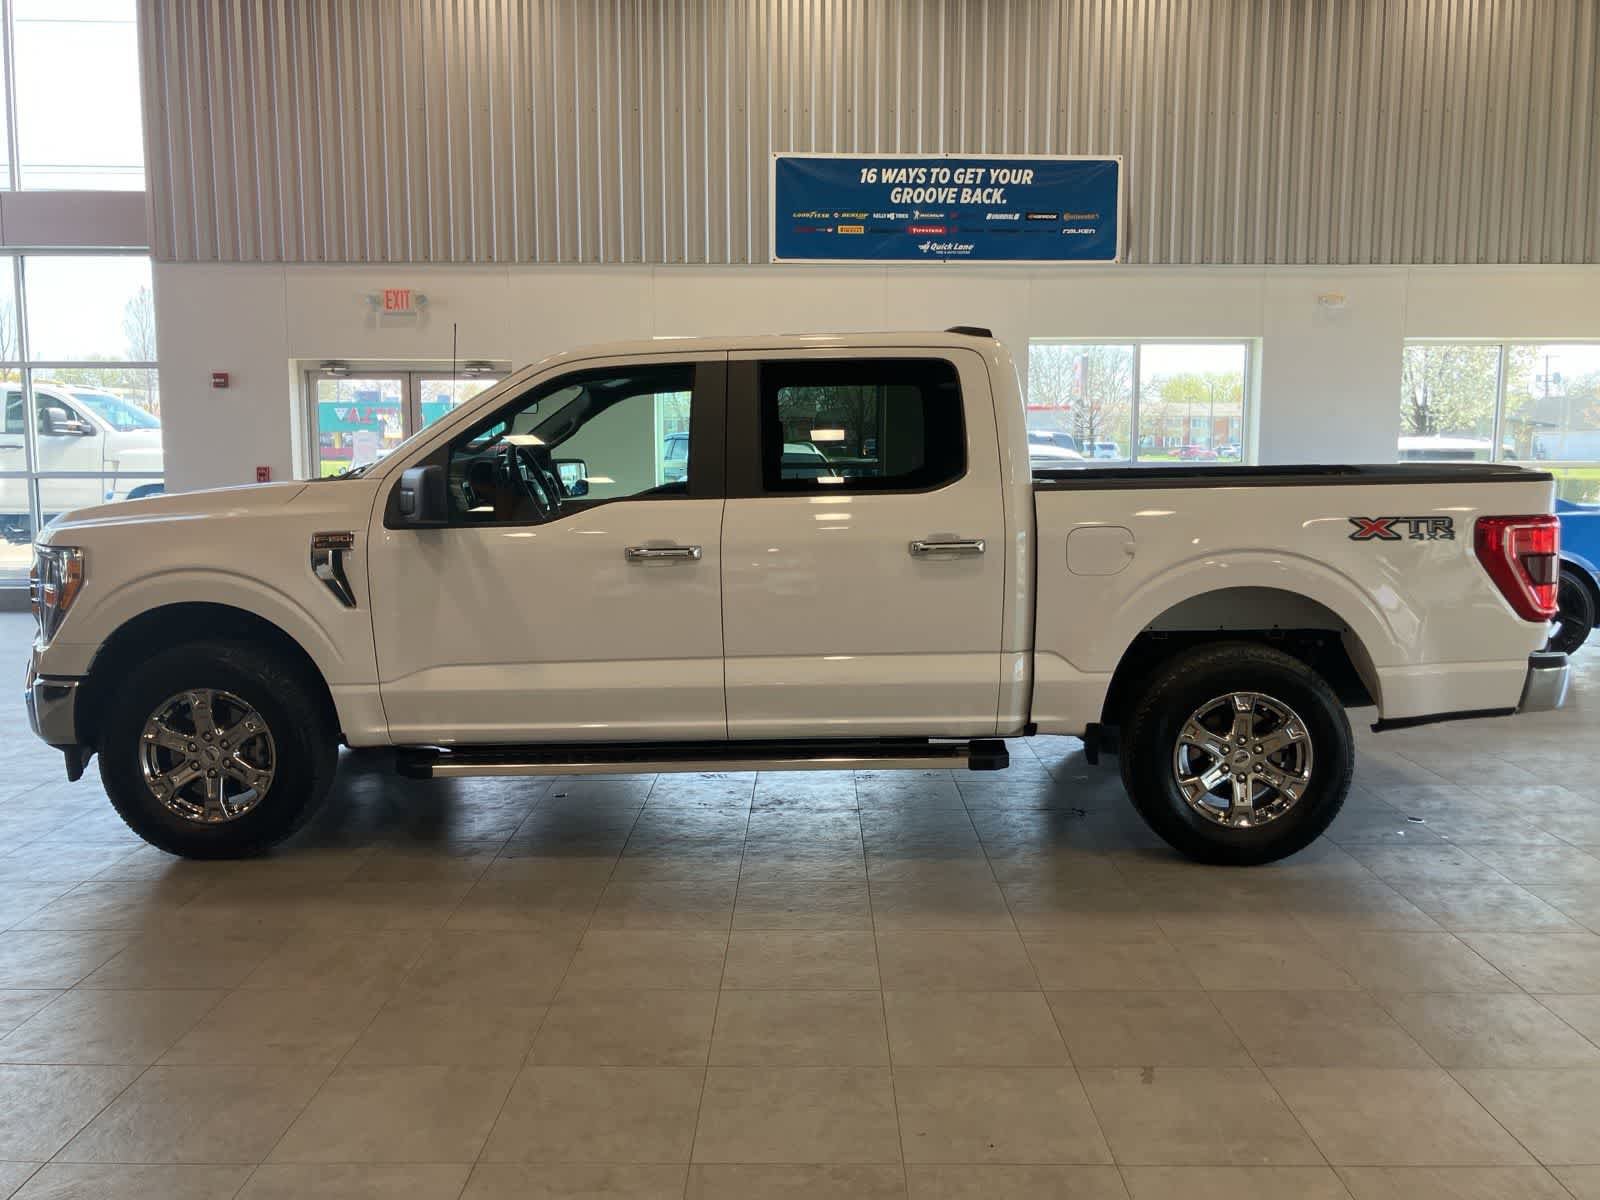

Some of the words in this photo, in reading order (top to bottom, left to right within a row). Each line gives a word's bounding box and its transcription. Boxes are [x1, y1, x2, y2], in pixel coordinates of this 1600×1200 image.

[860, 168, 878, 184] 16
[881, 167, 927, 184] WAYS
[930, 168, 951, 184] TO
[953, 168, 986, 185] GET
[989, 168, 1034, 185] YOUR
[890, 187, 957, 204] GROOVE
[960, 188, 1008, 204] BACK.
[930, 242, 953, 251] Quick
[953, 242, 975, 250] Lane
[385, 290, 409, 310] EXIT
